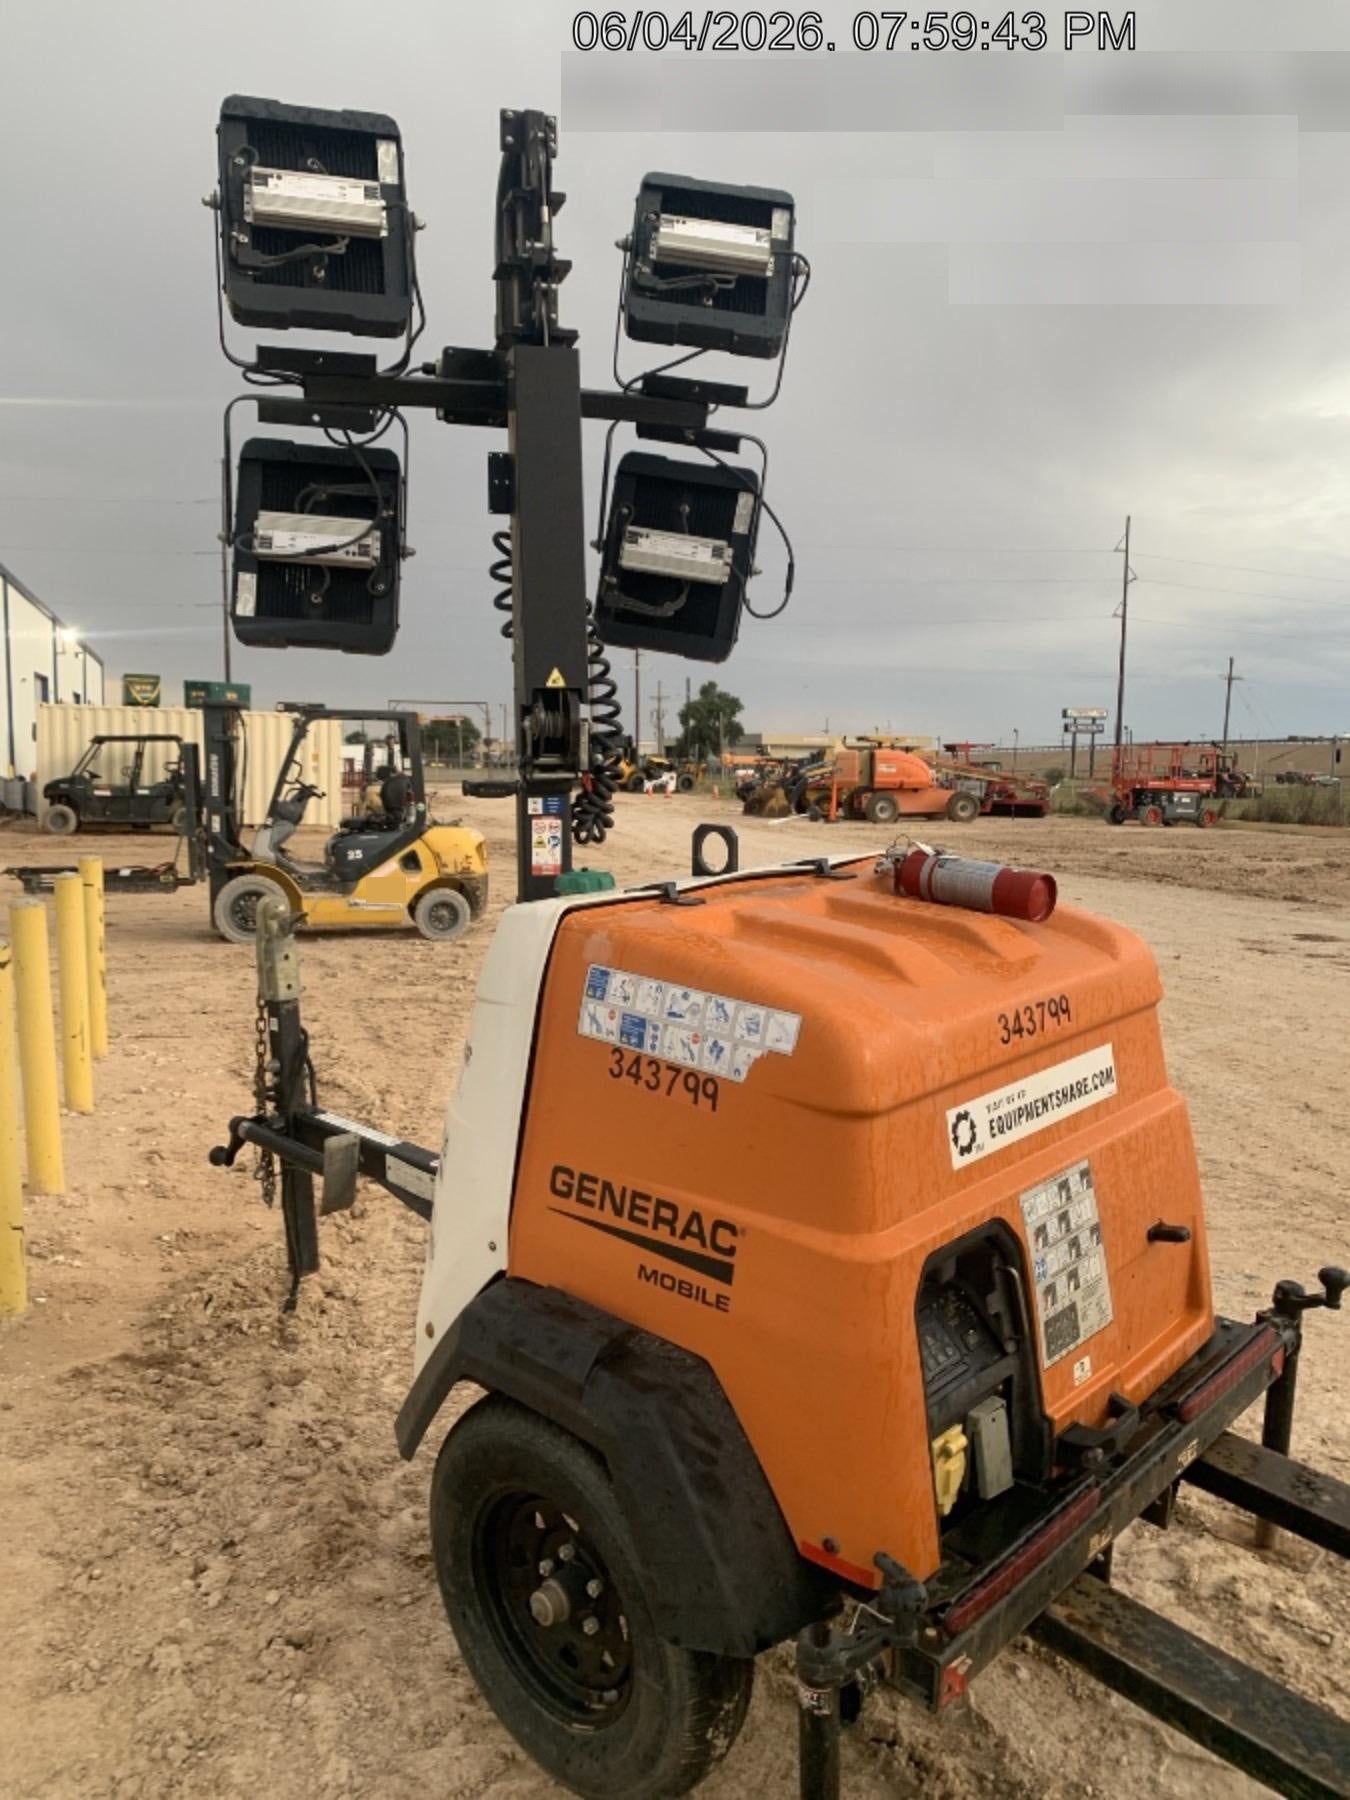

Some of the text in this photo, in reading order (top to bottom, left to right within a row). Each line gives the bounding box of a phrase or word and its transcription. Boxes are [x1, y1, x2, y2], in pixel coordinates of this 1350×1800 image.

[997, 994, 1071, 1045] 343799
[608, 1047, 719, 1112] 343799
[988, 1066, 1115, 1138] EQUIPMENTSHARE.COM
[549, 1164, 738, 1257] GENERAC
[637, 1263, 731, 1313] MOBILE
